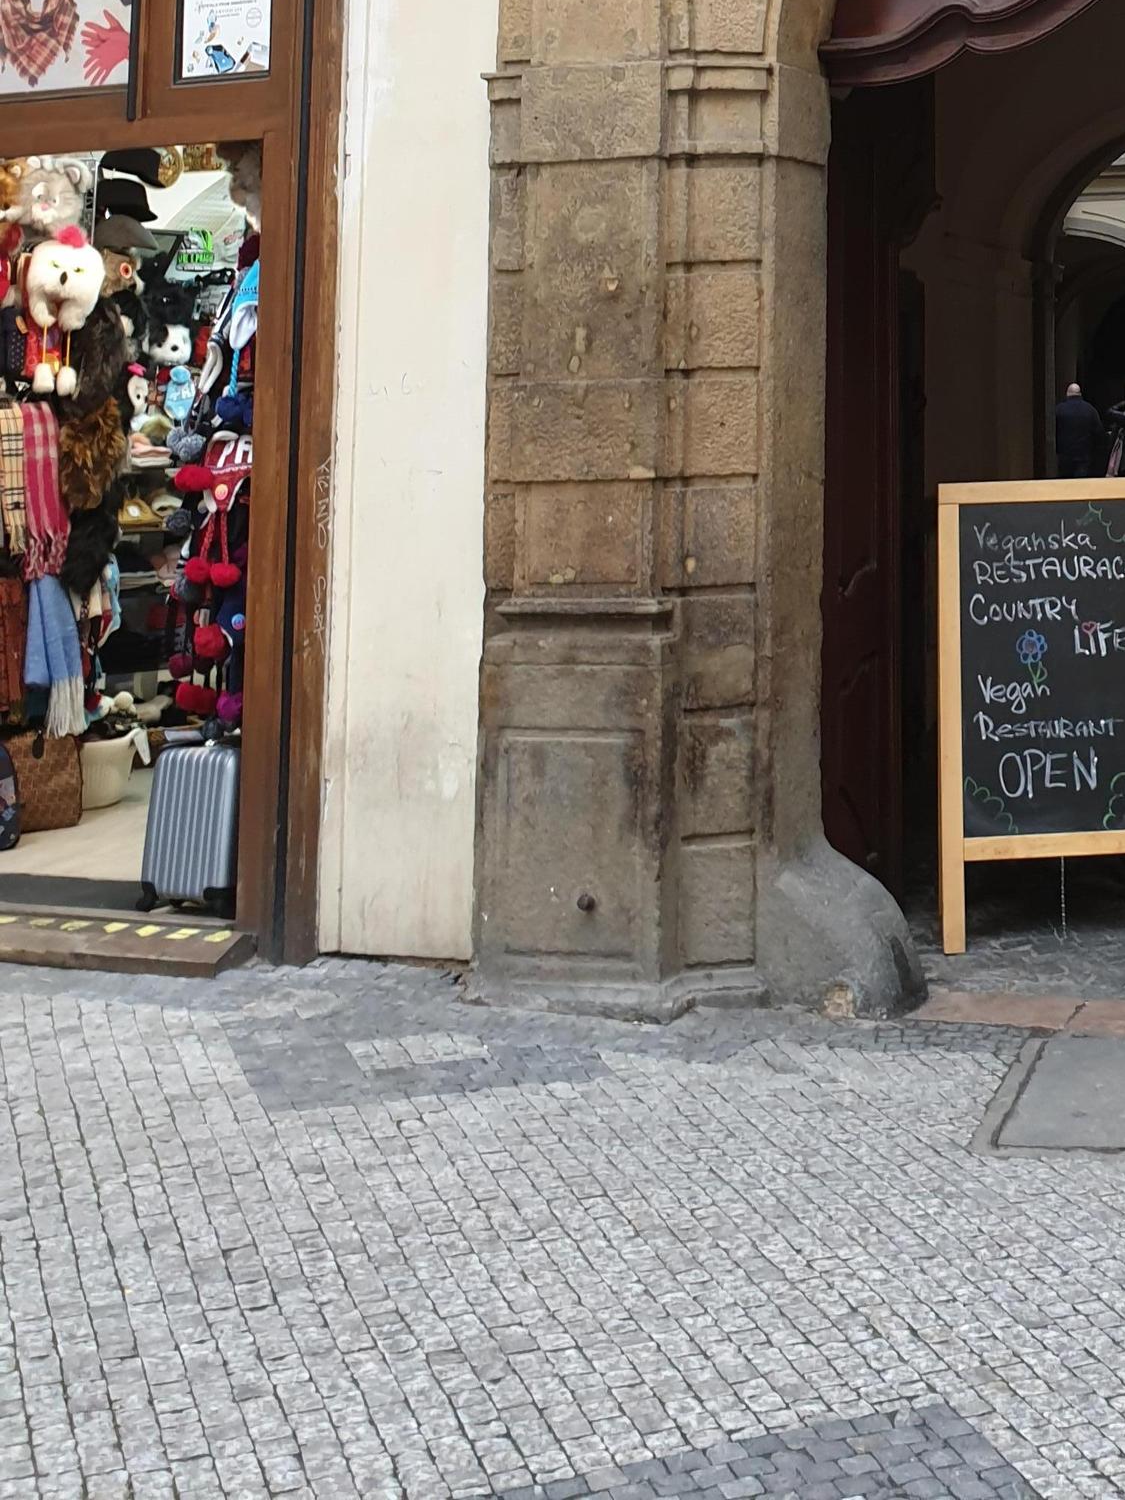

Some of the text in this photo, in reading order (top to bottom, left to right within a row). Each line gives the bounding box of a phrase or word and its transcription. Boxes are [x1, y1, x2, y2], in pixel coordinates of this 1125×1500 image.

[973, 519, 1097, 566] Veganska
[977, 674, 1050, 715] Vegan
[998, 746, 1098, 800] OPEN
